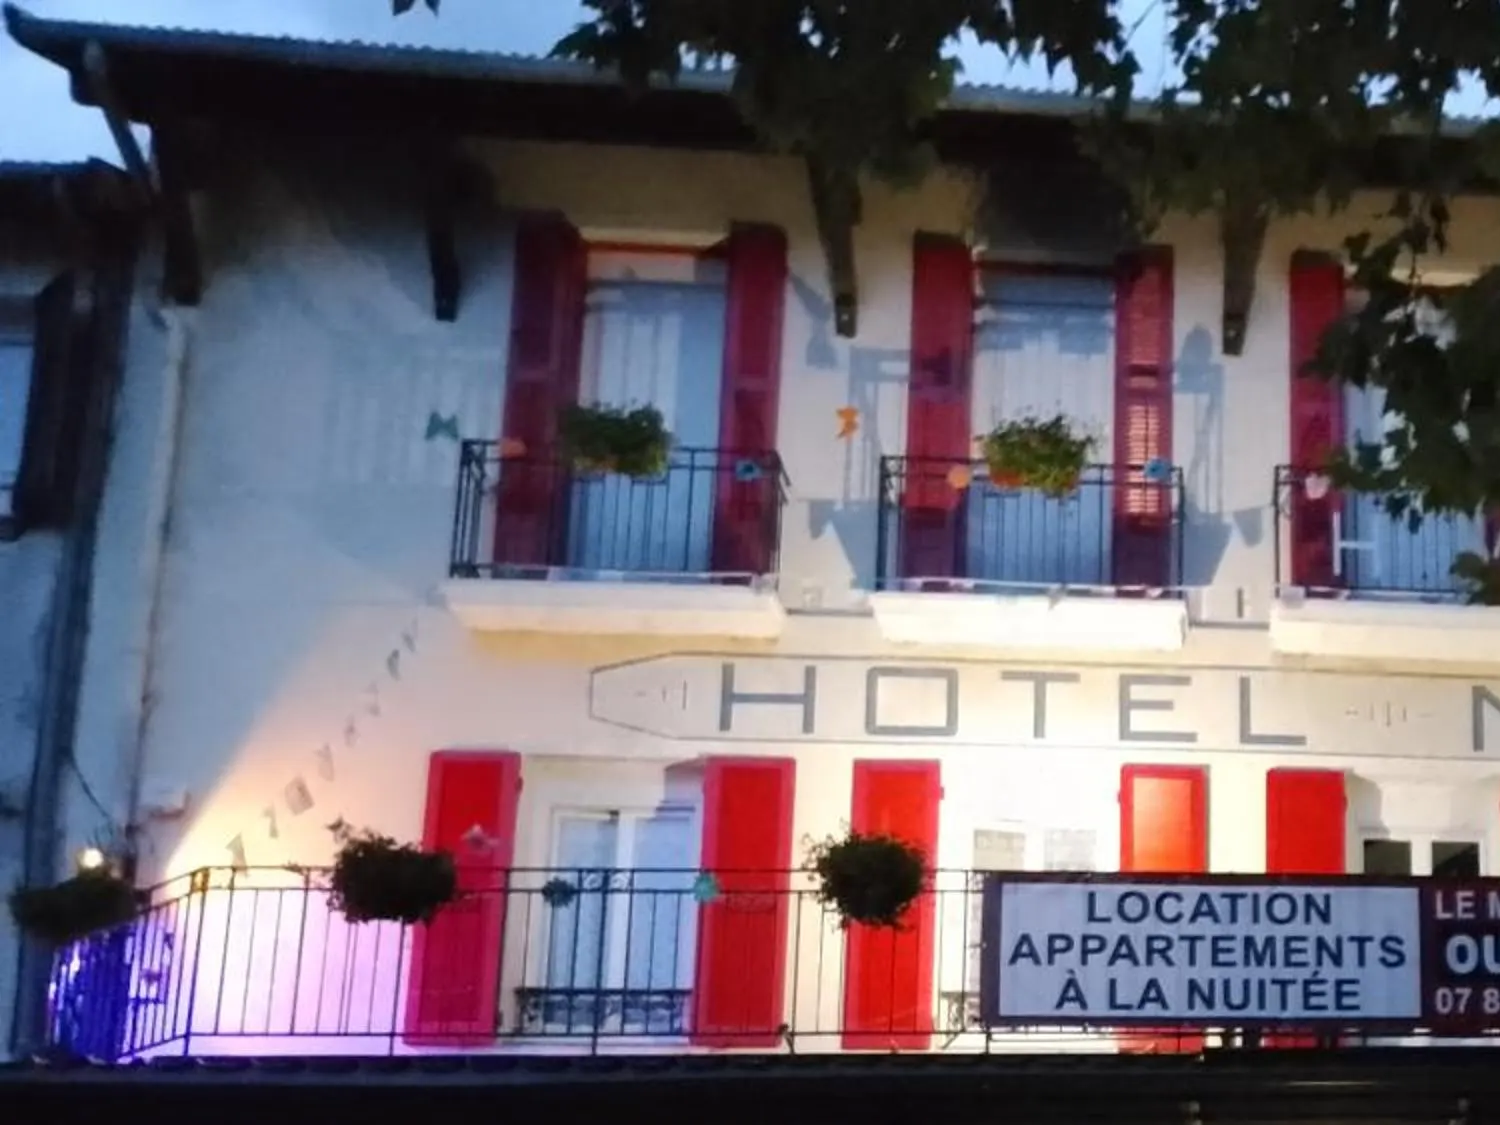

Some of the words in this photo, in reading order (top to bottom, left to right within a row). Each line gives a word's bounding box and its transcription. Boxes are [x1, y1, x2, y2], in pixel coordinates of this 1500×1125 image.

[719, 663, 1306, 745] HOTEL
[1087, 891, 1332, 925] LOCATION
[1435, 890, 1476, 921] LE
[1008, 933, 1407, 968] APPARTEMENTS
[1055, 970, 1088, 1010] À
[1108, 977, 1170, 1011] LA
[1186, 971, 1361, 1011] NUITÉE
[1435, 986, 1473, 1015] 07
